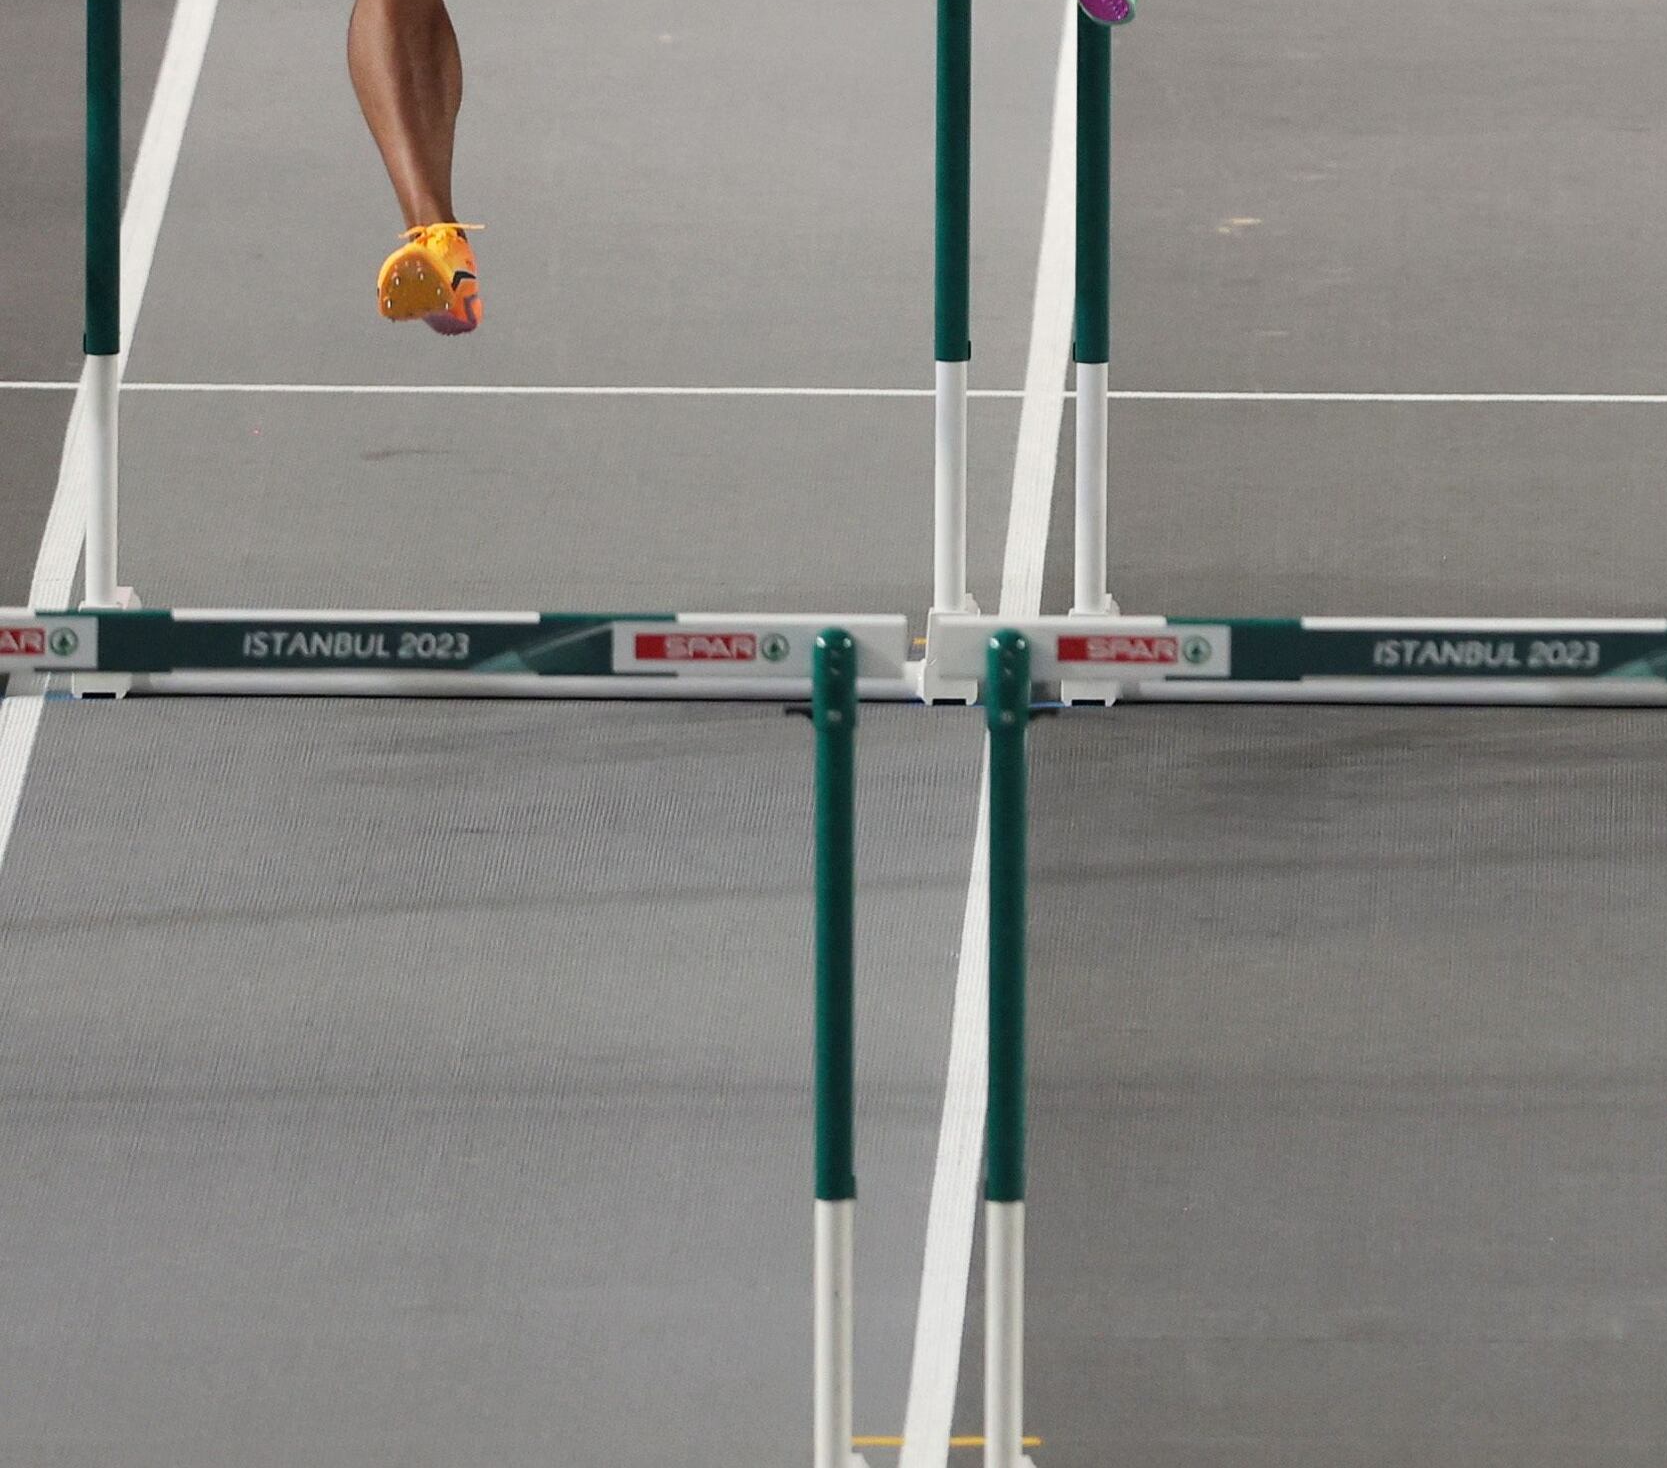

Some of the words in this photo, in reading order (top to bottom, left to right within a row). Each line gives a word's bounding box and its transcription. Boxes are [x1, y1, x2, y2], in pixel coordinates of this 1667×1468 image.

[0, 629, 43, 653] AR
[242, 631, 390, 659] ISTANBUL
[397, 633, 471, 660] 2023
[664, 635, 755, 660] SPAR
[1087, 637, 1177, 662] SPAR
[1373, 640, 1520, 667] ISTANBUL
[1527, 640, 1599, 668] 2023
